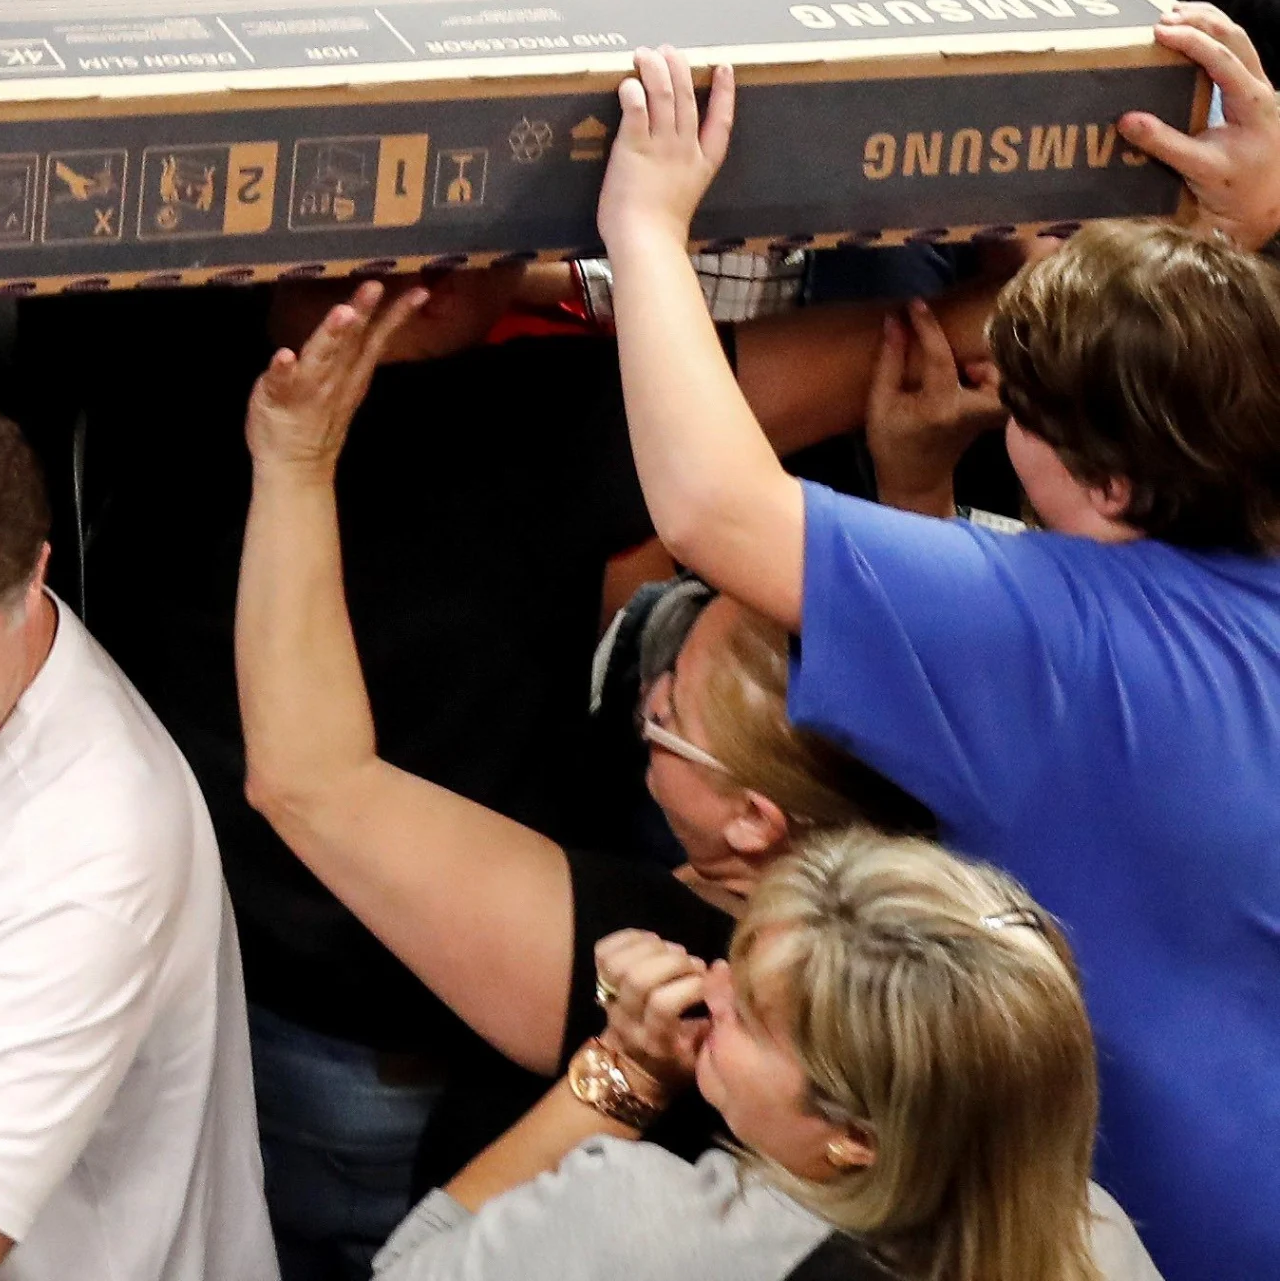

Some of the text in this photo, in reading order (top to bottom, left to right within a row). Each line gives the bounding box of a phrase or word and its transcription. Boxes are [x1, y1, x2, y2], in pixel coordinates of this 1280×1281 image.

[306, 44, 359, 61] HDR
[425, 36, 570, 55] PROCESSOR
[5, 45, 45, 67] 4K
[78, 51, 237, 71] DESIGN SLIM
